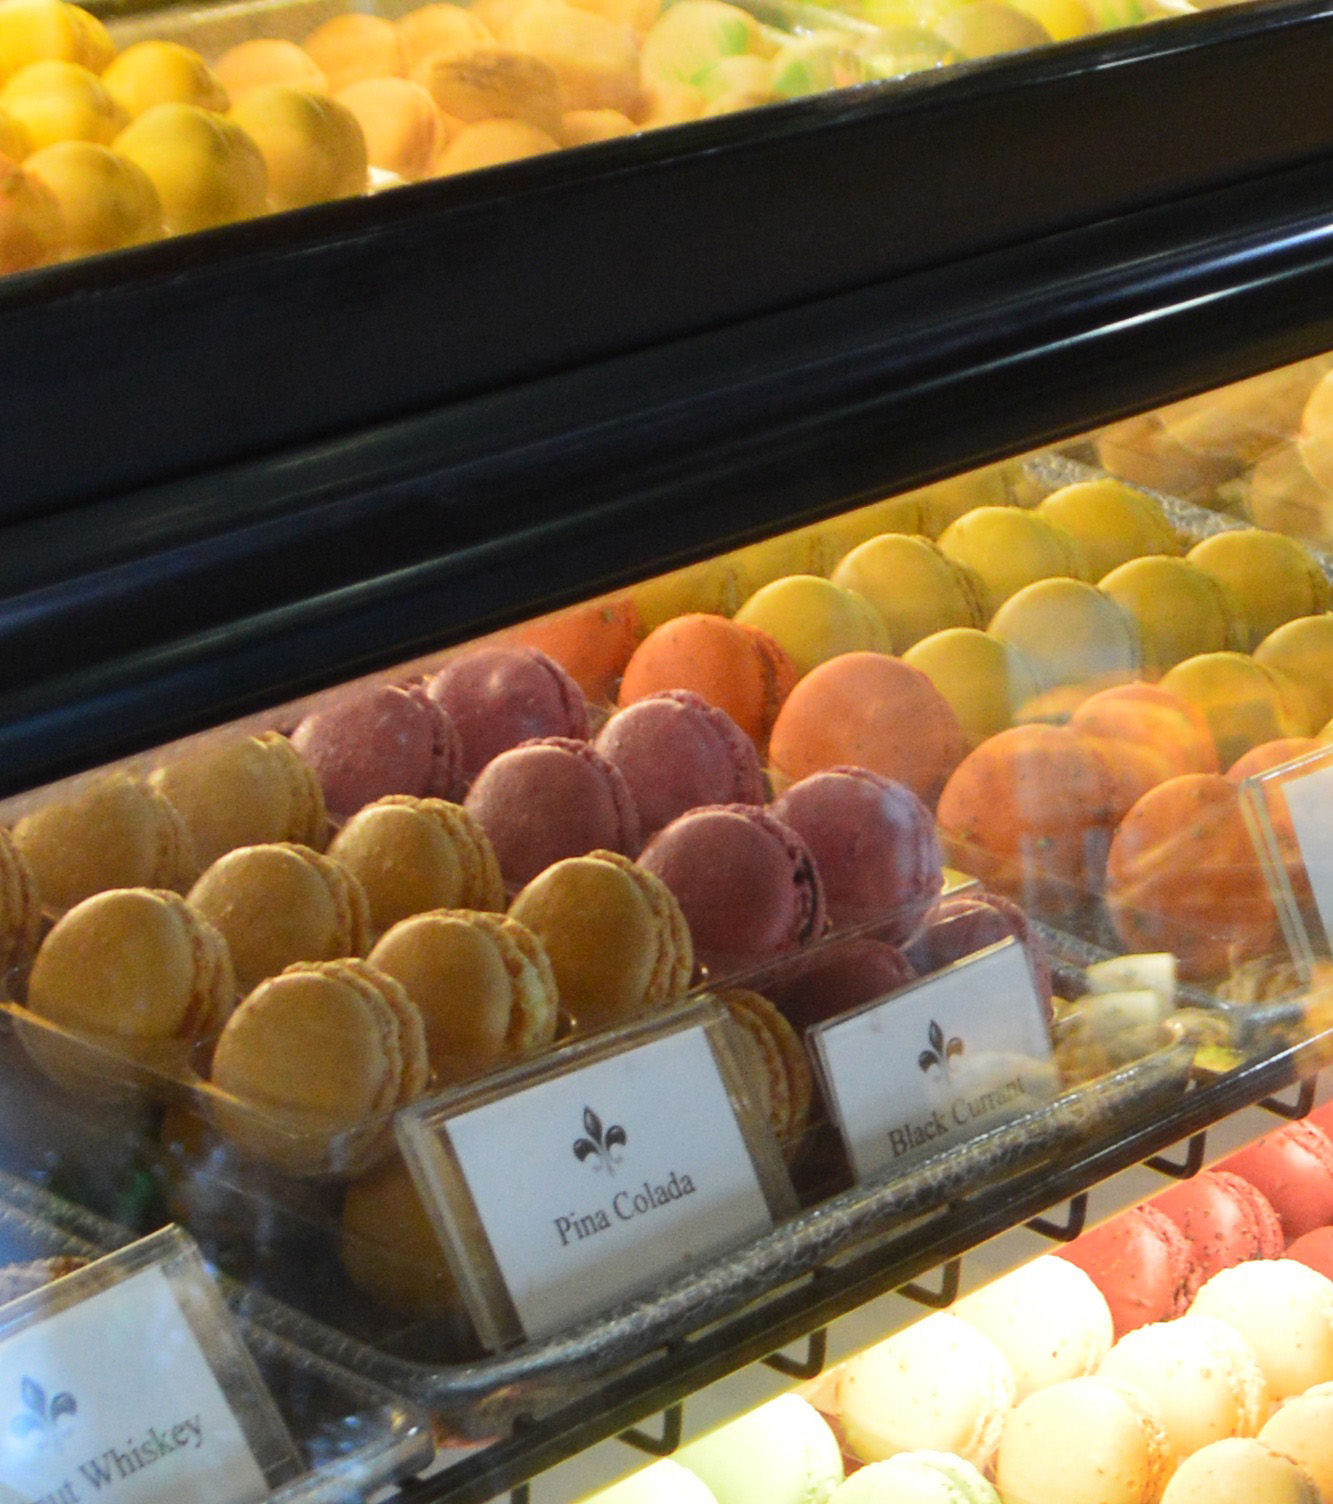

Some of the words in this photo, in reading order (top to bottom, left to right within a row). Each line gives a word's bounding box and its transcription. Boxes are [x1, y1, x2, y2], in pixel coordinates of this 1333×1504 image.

[887, 1112, 949, 1160] Black
[950, 1076, 1026, 1136] Currant
[552, 1209, 612, 1248] Pina
[611, 1170, 697, 1223] Colada
[78, 1412, 205, 1492] Whiskey
